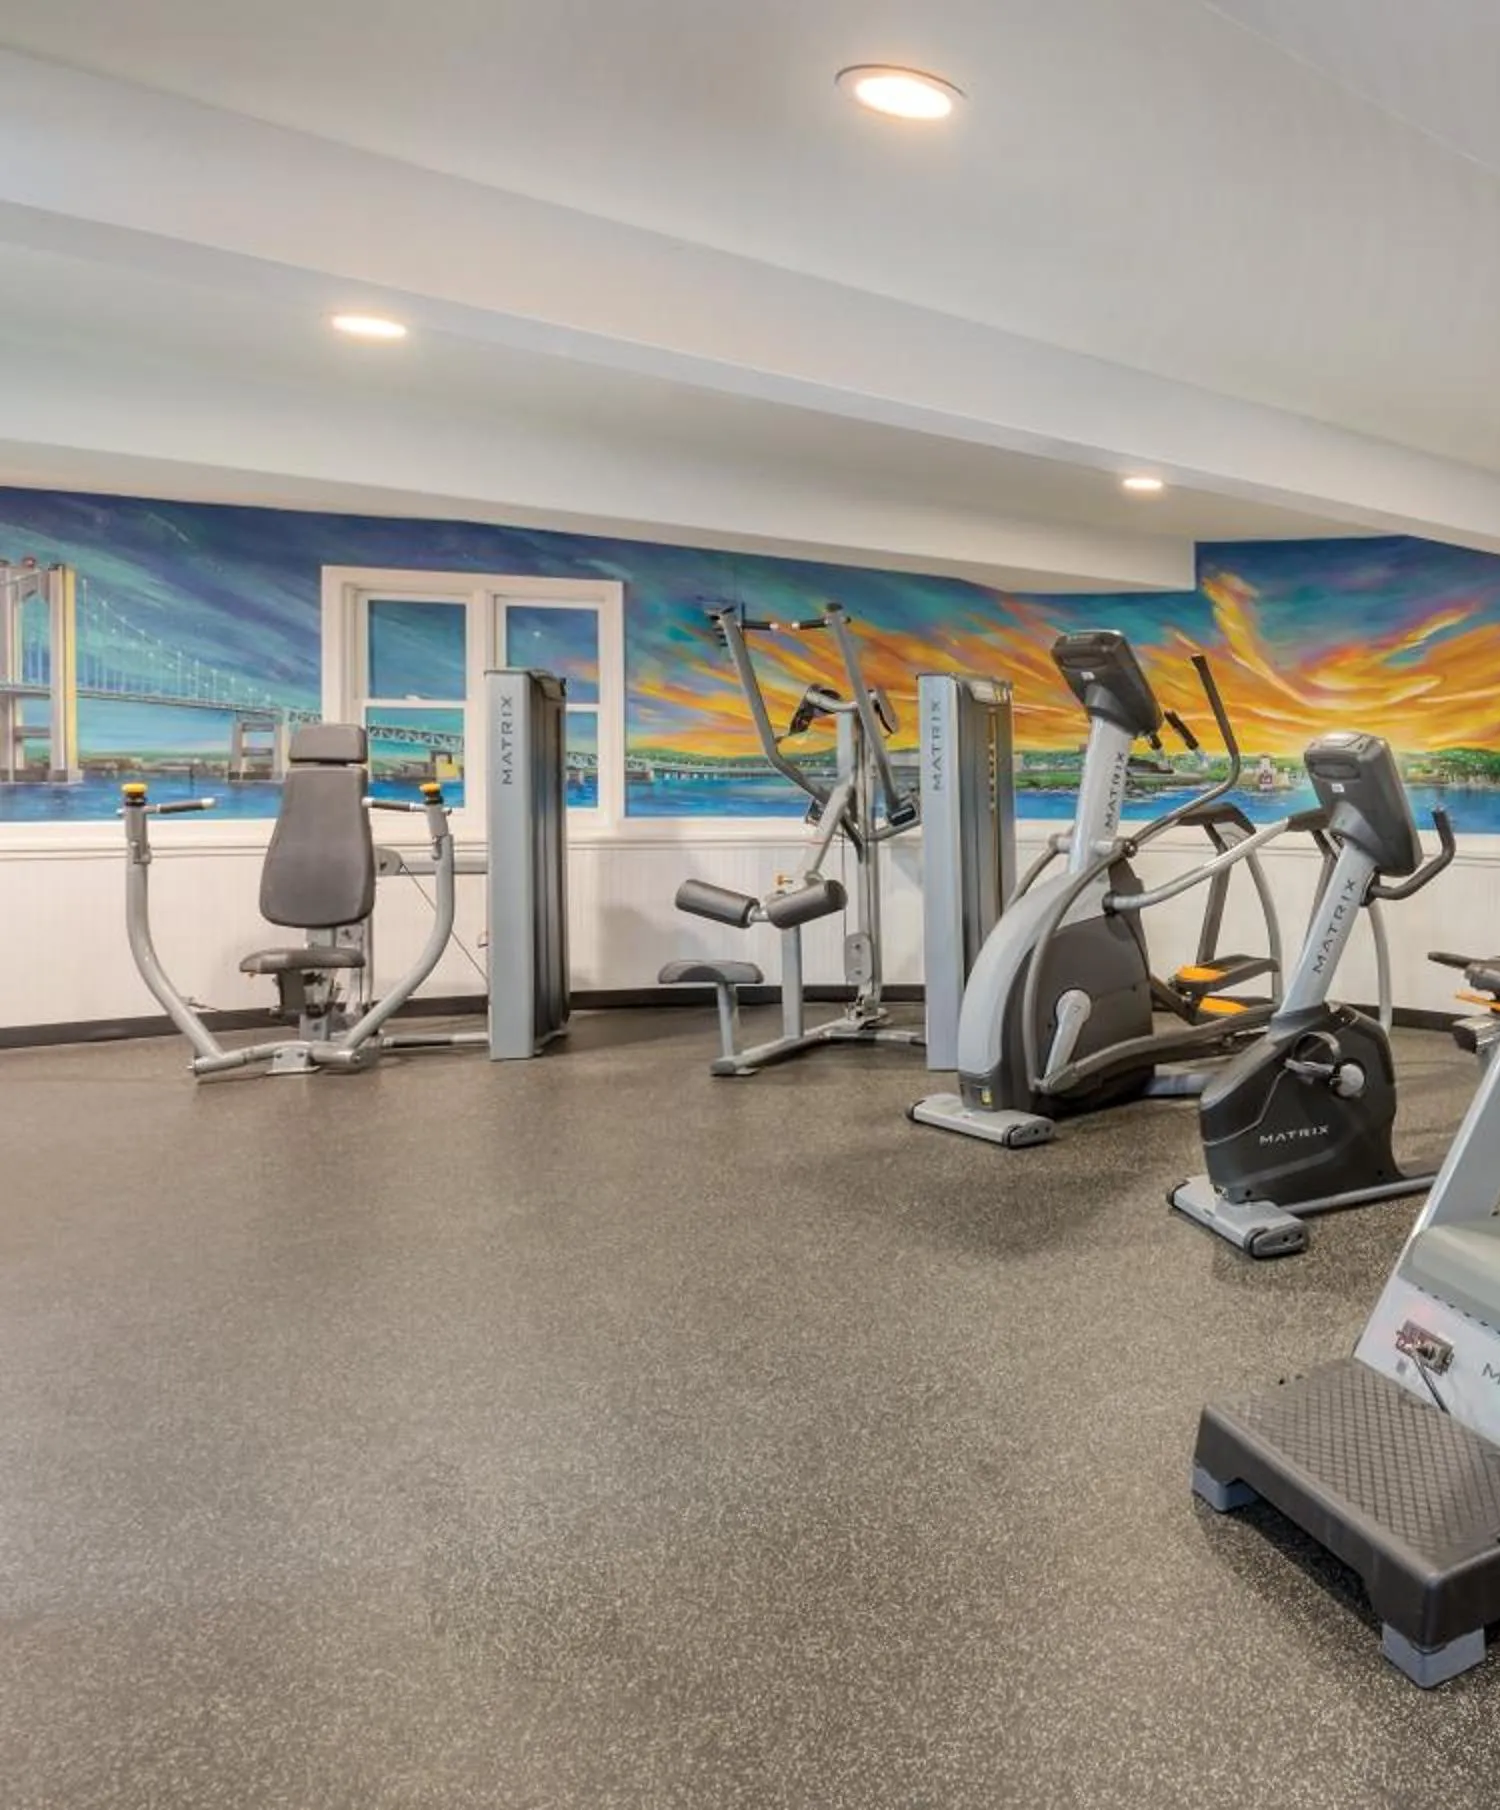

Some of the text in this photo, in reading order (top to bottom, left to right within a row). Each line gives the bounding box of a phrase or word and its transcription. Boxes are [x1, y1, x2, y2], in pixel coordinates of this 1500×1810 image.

[501, 696, 513, 785] MATRIX
[931, 700, 942, 791] MATRIX
[1105, 752, 1125, 830] MATRIX
[1312, 879, 1355, 974] MATRIX
[1260, 1124, 1329, 1145] MATRIX
